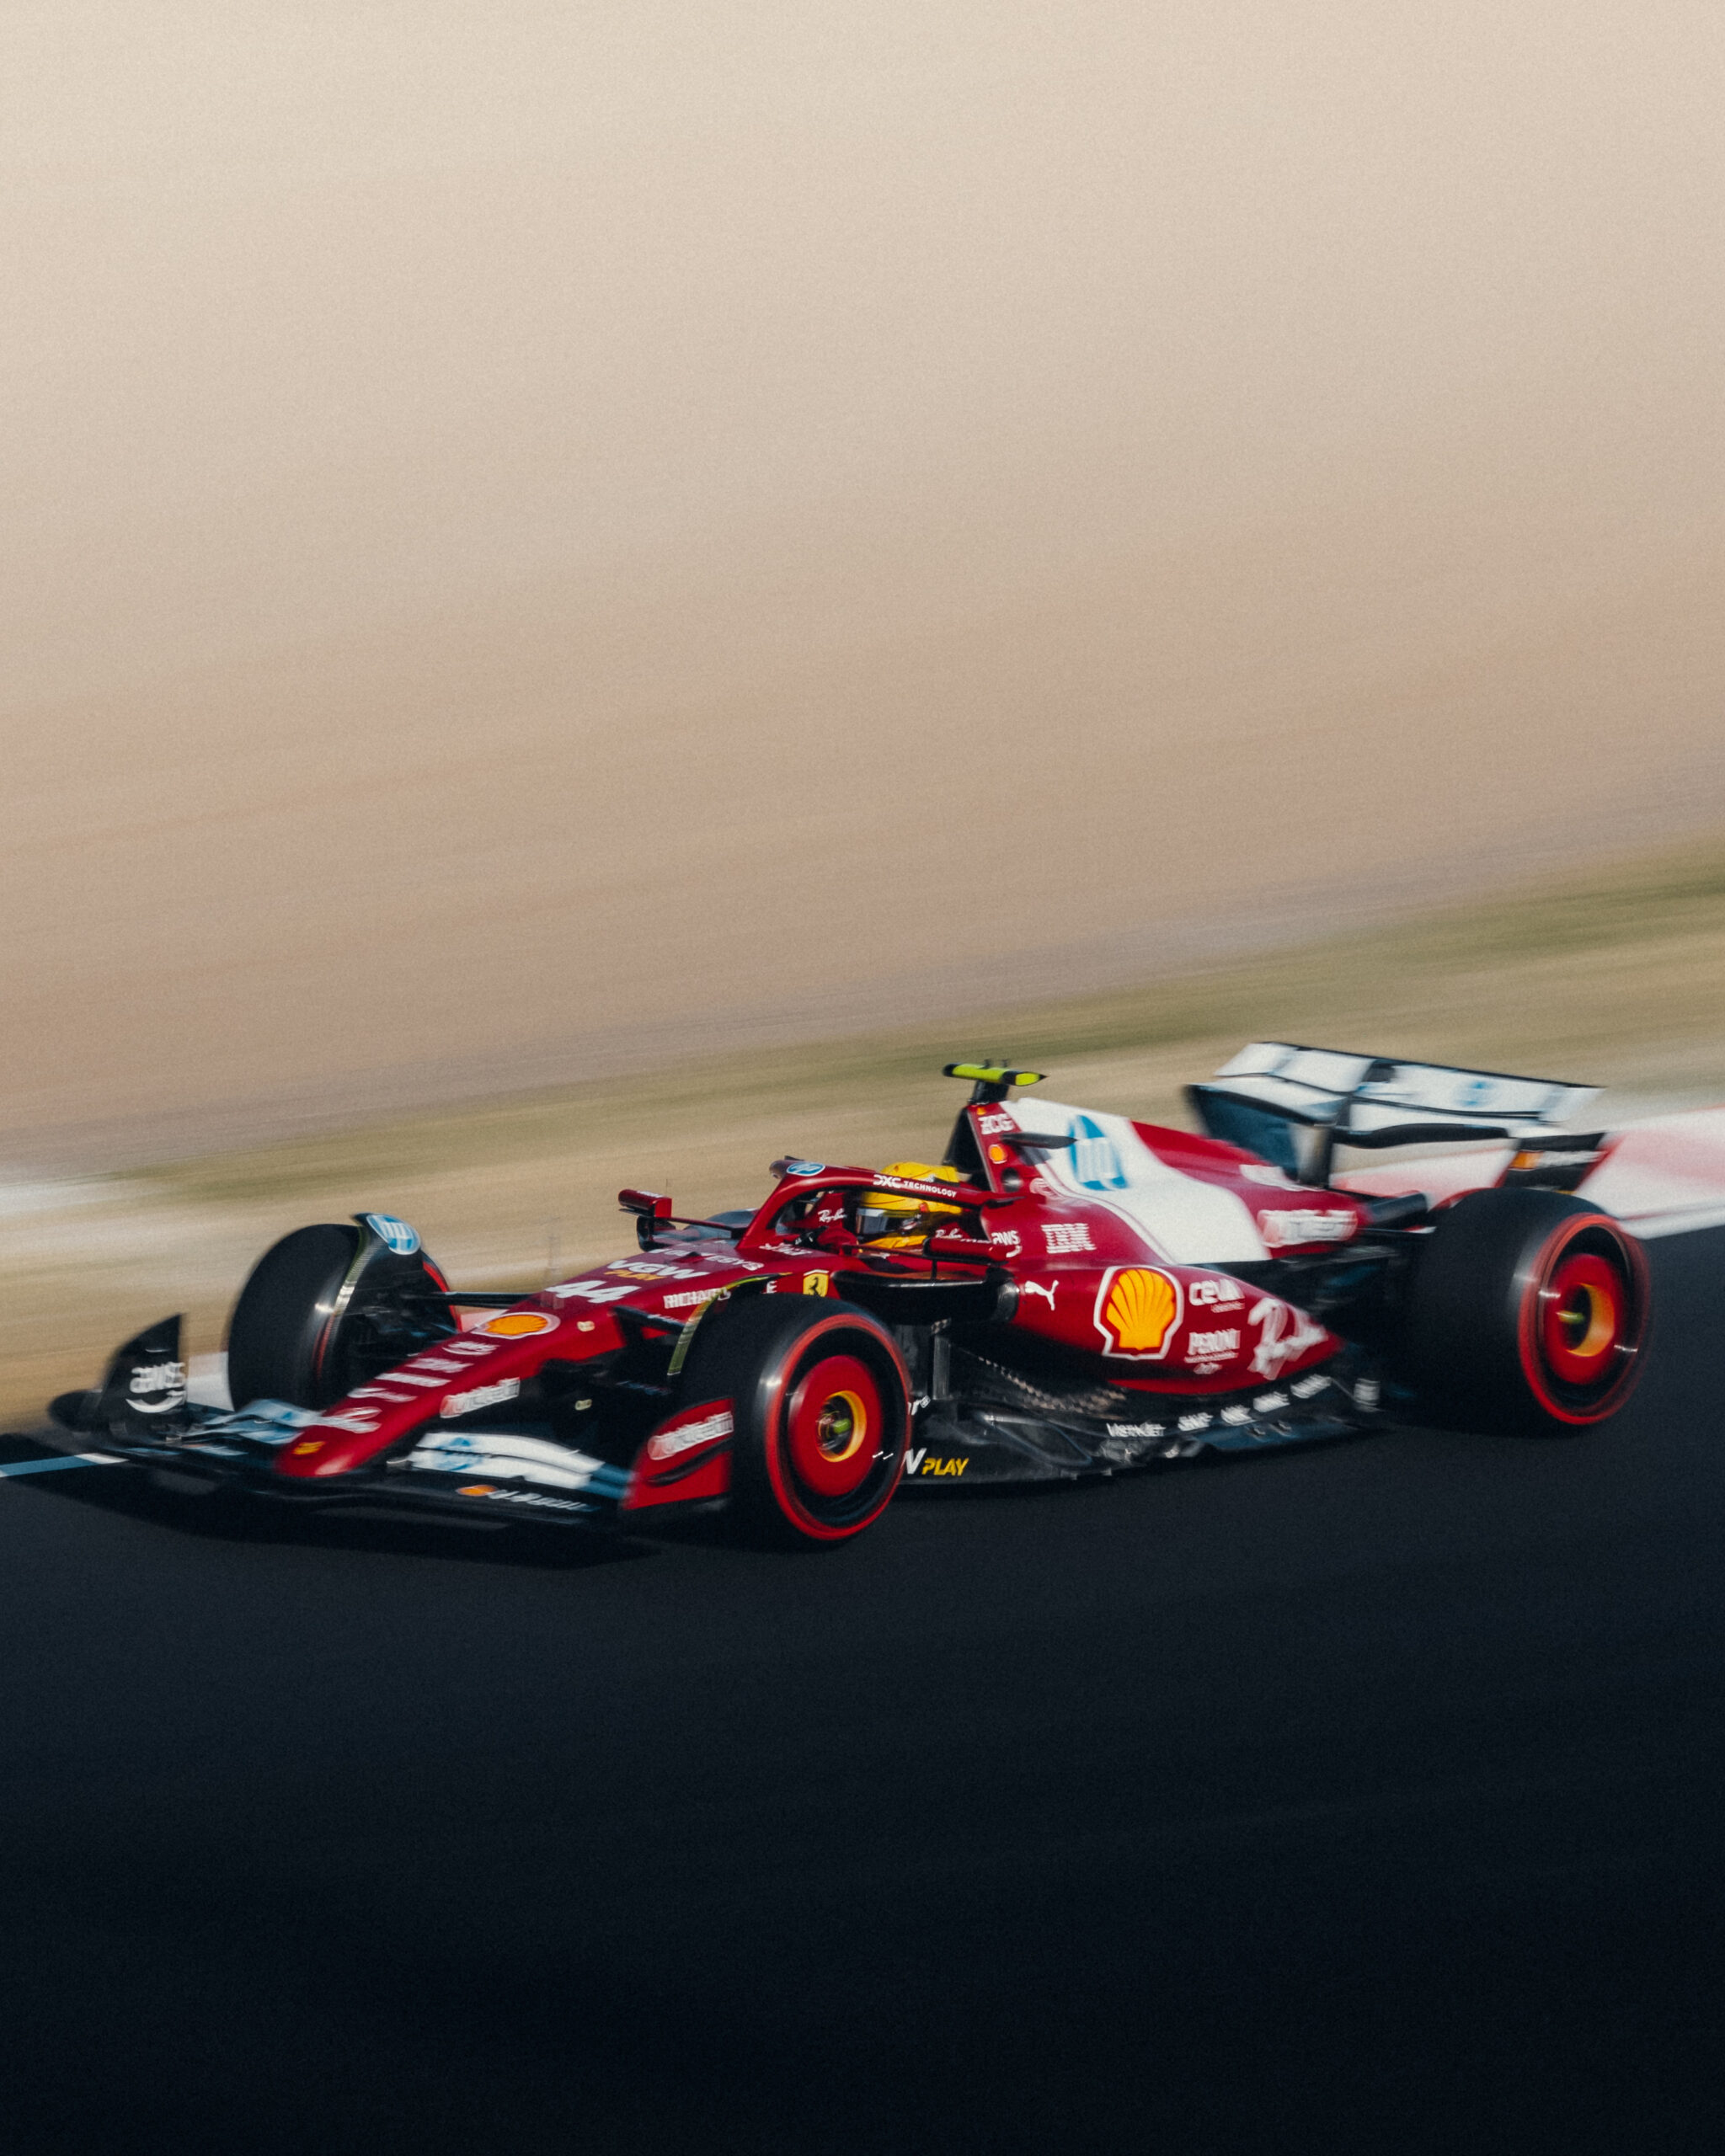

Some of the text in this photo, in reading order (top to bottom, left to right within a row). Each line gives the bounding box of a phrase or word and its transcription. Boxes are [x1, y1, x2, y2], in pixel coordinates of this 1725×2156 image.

[873, 1174, 957, 1198] DXC TECHNOLOGY
[607, 1260, 710, 1279] VGW
[544, 1280, 642, 1303] 44
[921, 1458, 969, 1476] PLAY
